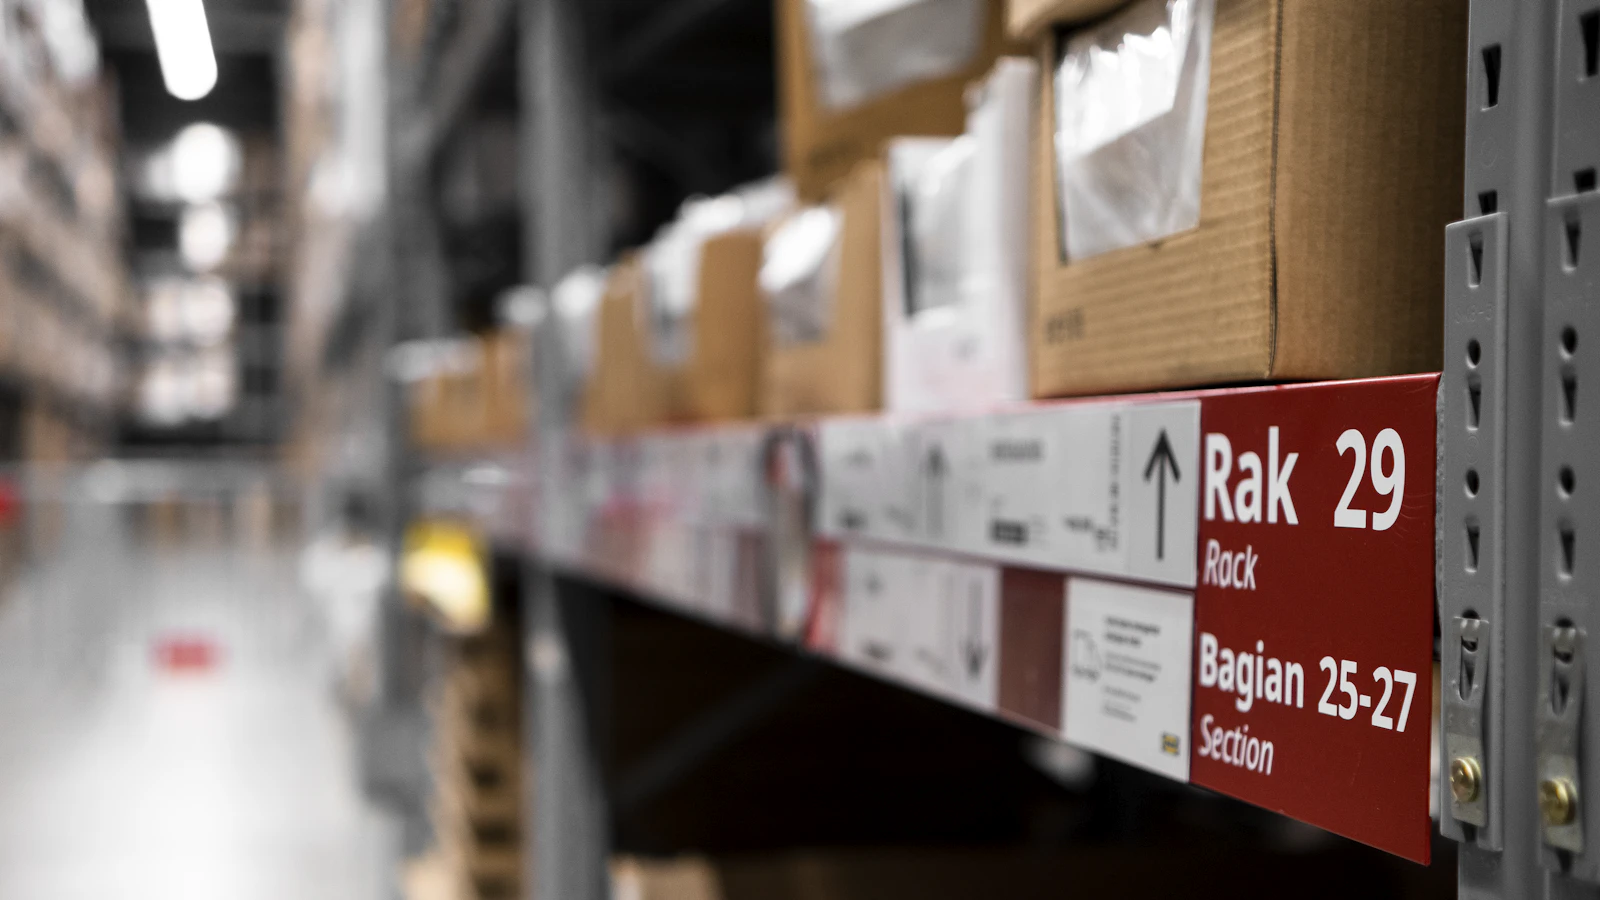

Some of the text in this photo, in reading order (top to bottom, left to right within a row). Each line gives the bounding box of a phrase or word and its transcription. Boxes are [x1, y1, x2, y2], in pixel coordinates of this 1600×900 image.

[1205, 426, 1299, 525] Rak
[1334, 428, 1405, 530] 29
[1203, 538, 1258, 591] Rack
[1199, 632, 1417, 732] Bagian 25-27
[1198, 714, 1274, 775] Section
